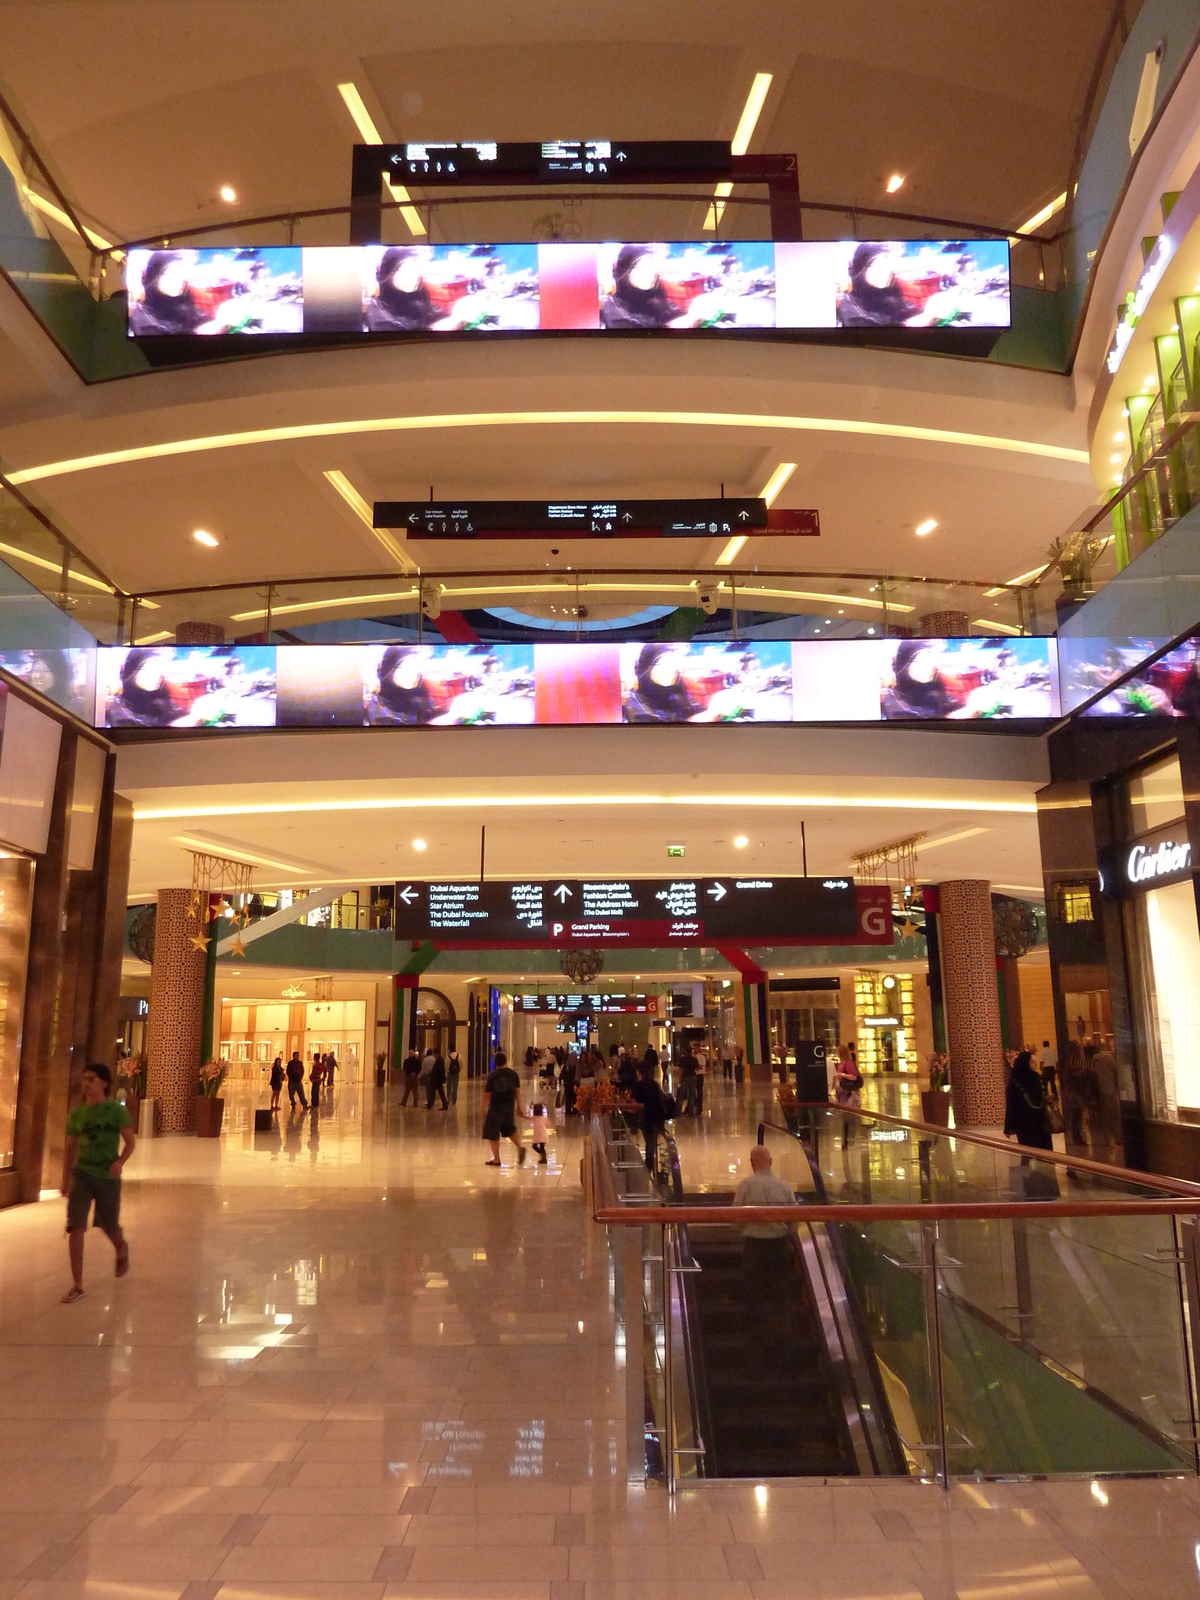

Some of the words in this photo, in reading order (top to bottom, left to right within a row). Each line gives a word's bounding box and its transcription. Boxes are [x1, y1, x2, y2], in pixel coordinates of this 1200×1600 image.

[786, 157, 797, 171] 2
[811, 512, 818, 527] 1
[1128, 841, 1191, 882] Cartier
[449, 885, 479, 893] Aquarium
[583, 883, 630, 891] Bloomingdale's
[736, 881, 755, 889] Grand
[583, 892, 607, 900] Fashion
[596, 900, 621, 908] Address
[462, 910, 488, 918] Fountain
[861, 907, 886, 935] G
[553, 923, 564, 937] P
[648, 1002, 656, 1011] G
[813, 1045, 824, 1058] G
